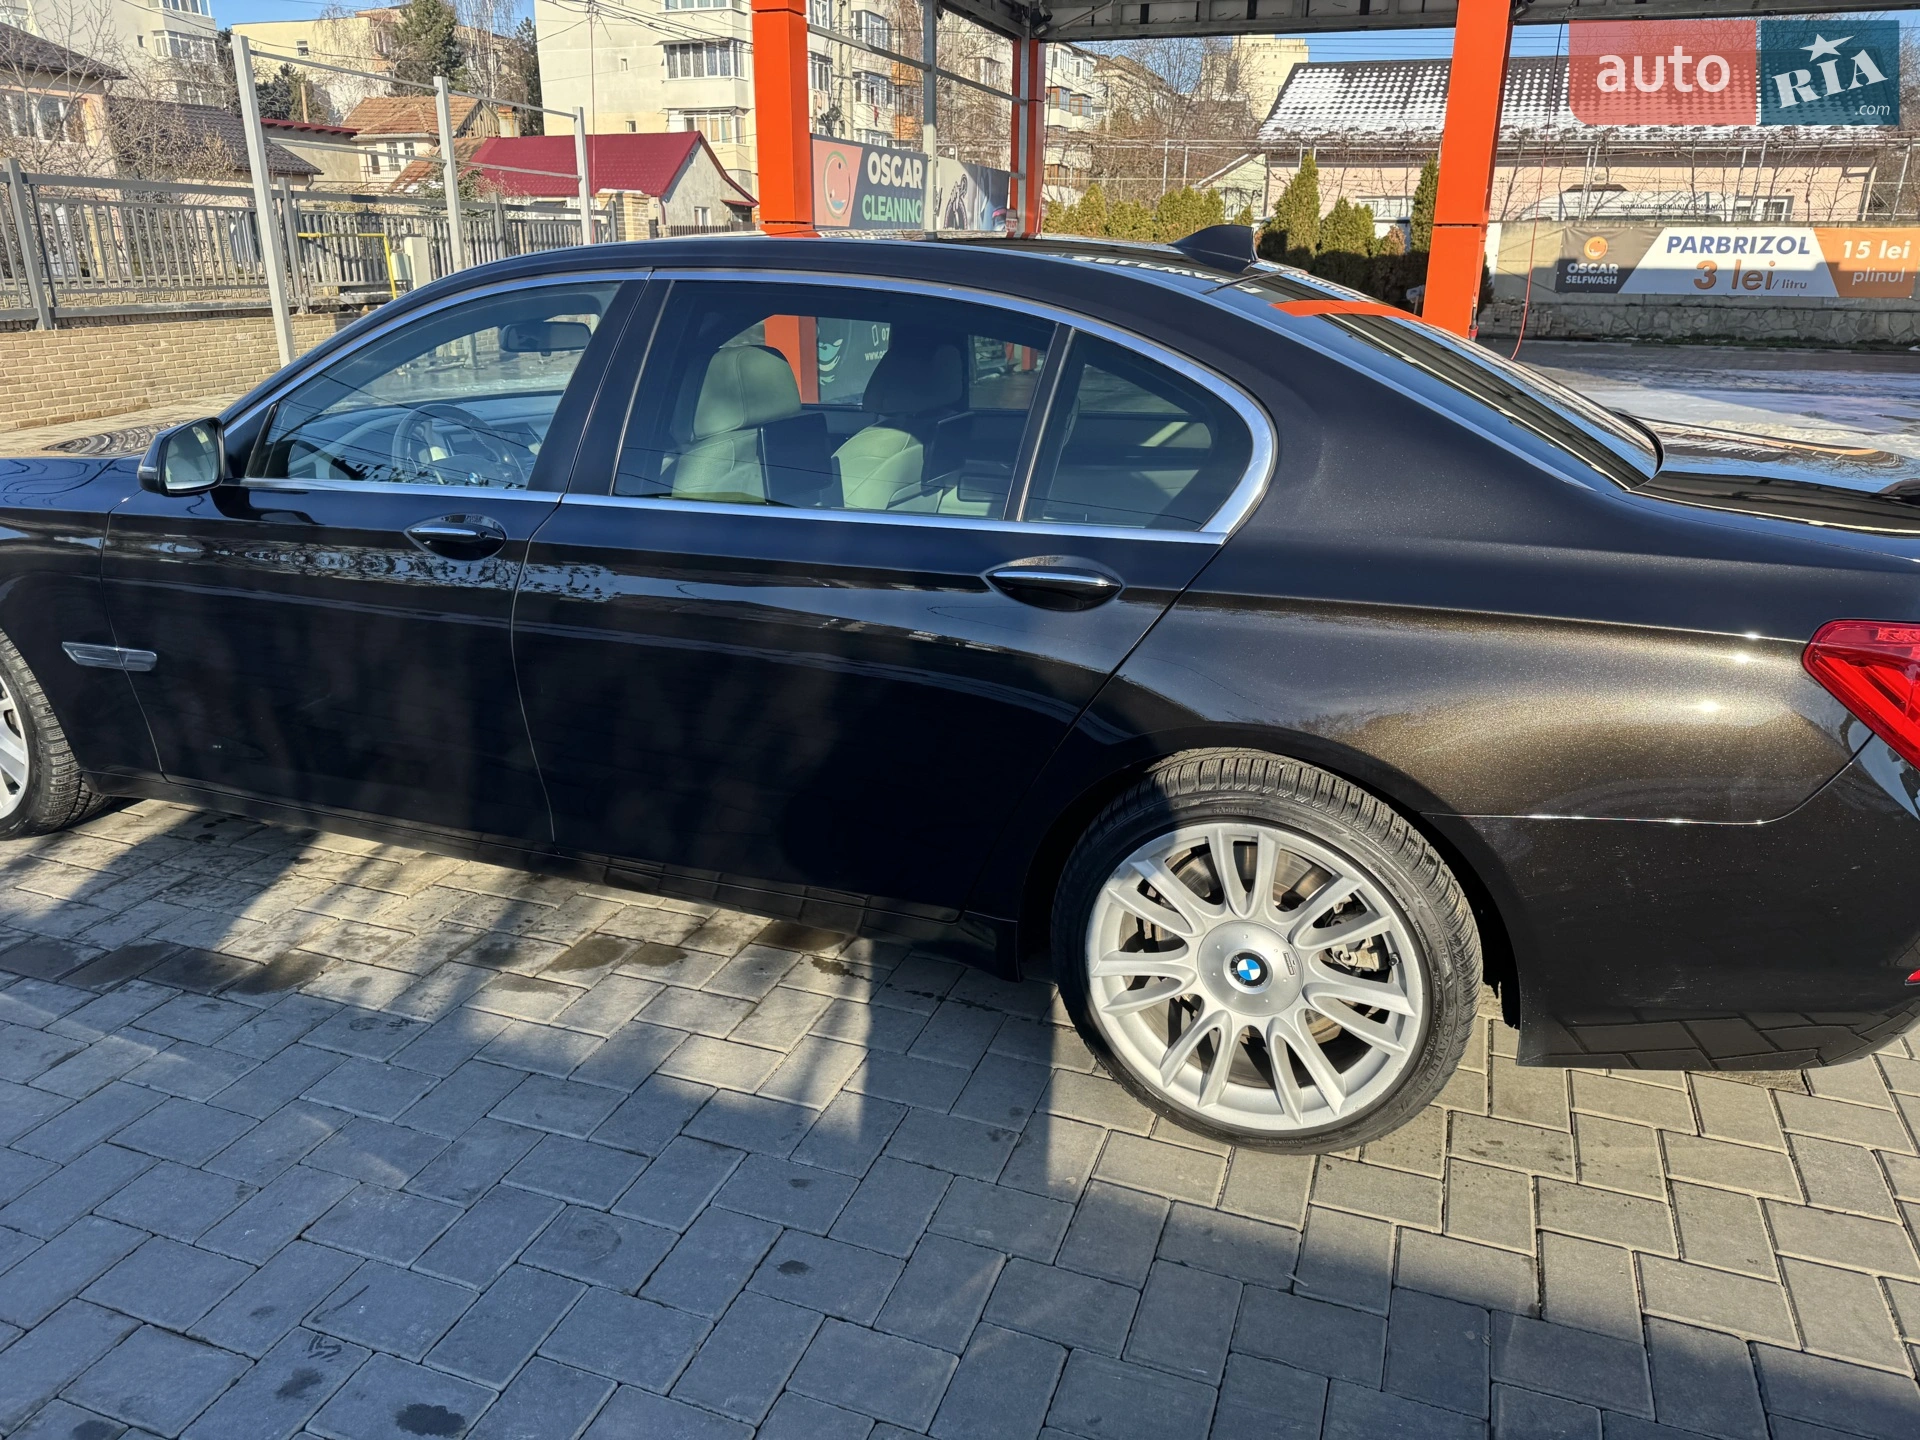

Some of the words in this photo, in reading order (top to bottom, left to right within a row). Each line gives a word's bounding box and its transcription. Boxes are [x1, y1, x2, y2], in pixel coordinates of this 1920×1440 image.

[867, 151, 922, 189] OSCAR
[862, 194, 922, 224] CLEANING
[1666, 235, 1811, 255] PARBRIZOL
[1843, 240, 1871, 259] 15
[1879, 239, 1912, 260] lei
[1567, 262, 1619, 275] OSCAR
[1693, 259, 1719, 290] 3
[1781, 279, 1808, 289] litru
[1851, 266, 1905, 286] plinul
[1565, 275, 1618, 285] SELFWASH
